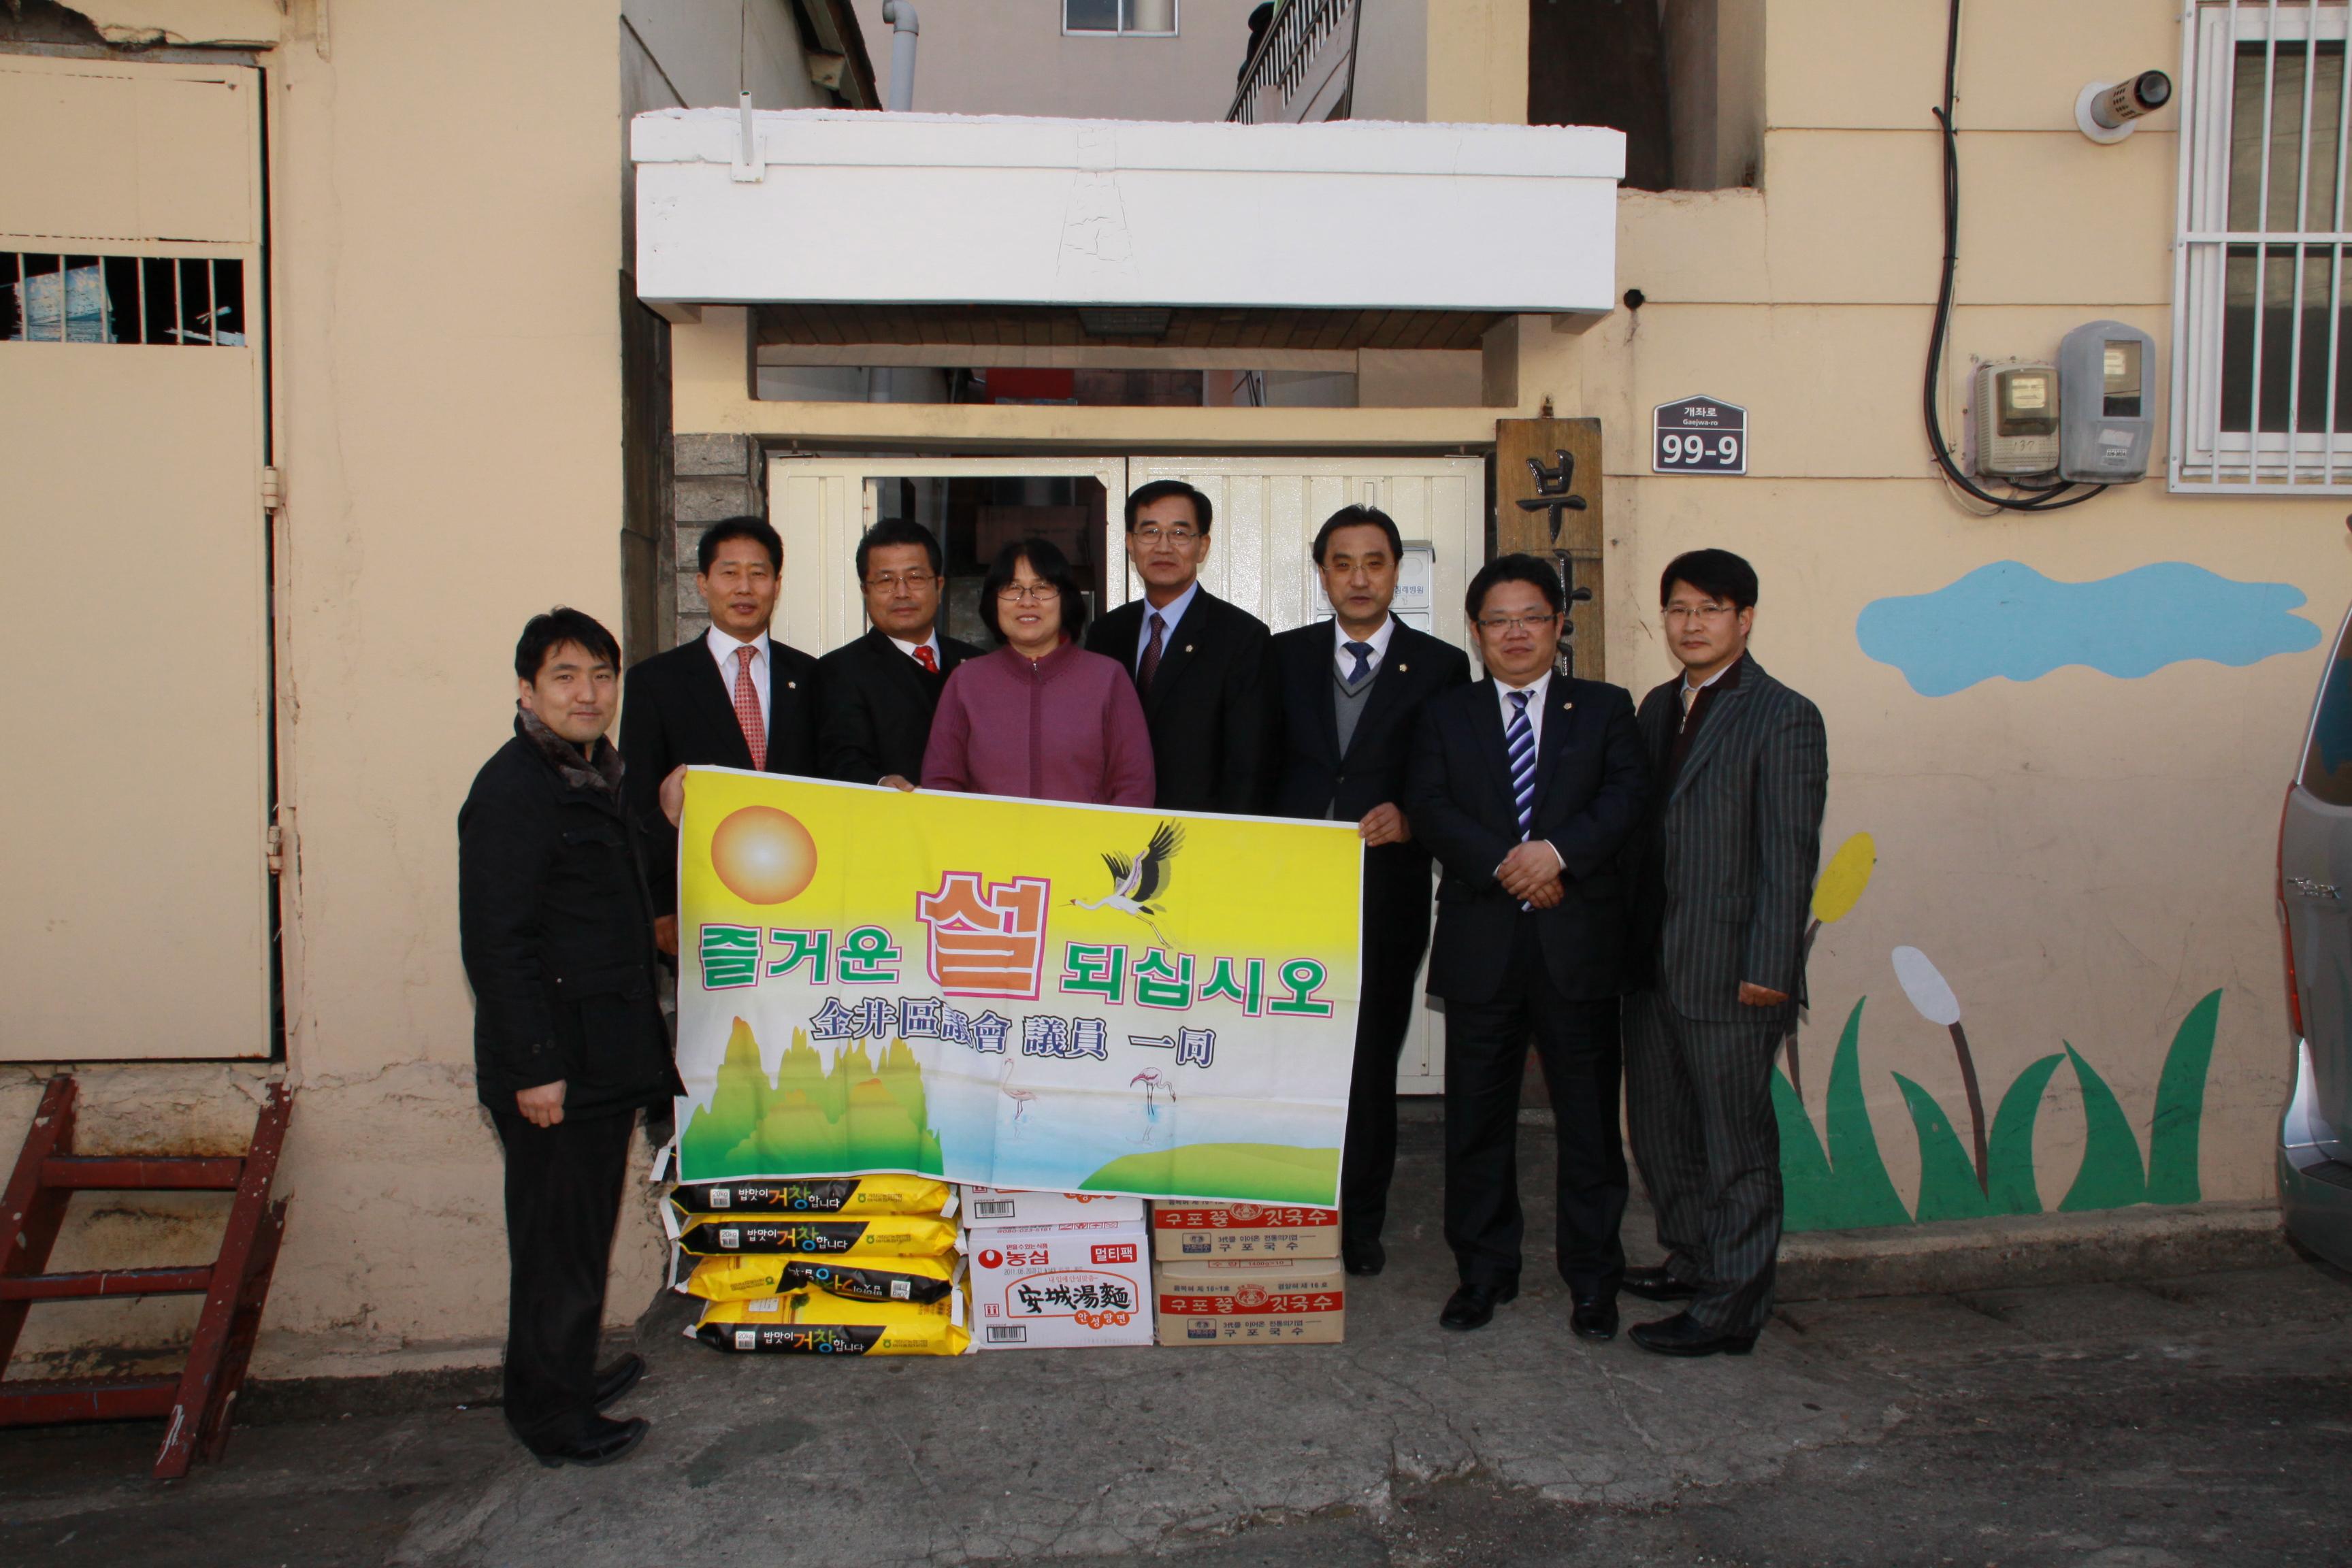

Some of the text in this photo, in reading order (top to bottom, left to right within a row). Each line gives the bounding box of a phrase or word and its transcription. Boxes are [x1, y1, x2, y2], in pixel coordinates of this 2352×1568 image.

[1684, 407, 1718, 417] 개좌로
[1682, 419, 1718, 427] Gaejwa-ro
[1663, 434, 1737, 465] 99-9
[700, 870, 1334, 1018] 즐거운 설 되십시오
[811, 997, 1216, 1068] 金井區議會 議員 一同
[712, 1190, 729, 1198] 20kg
[721, 1230, 737, 1239] 20kg
[1006, 1250, 1049, 1266] 농심
[1095, 1247, 1133, 1262] 멀티팩
[1077, 1313, 1126, 1327] 안성탕면
[738, 1333, 753, 1341] 20kg
